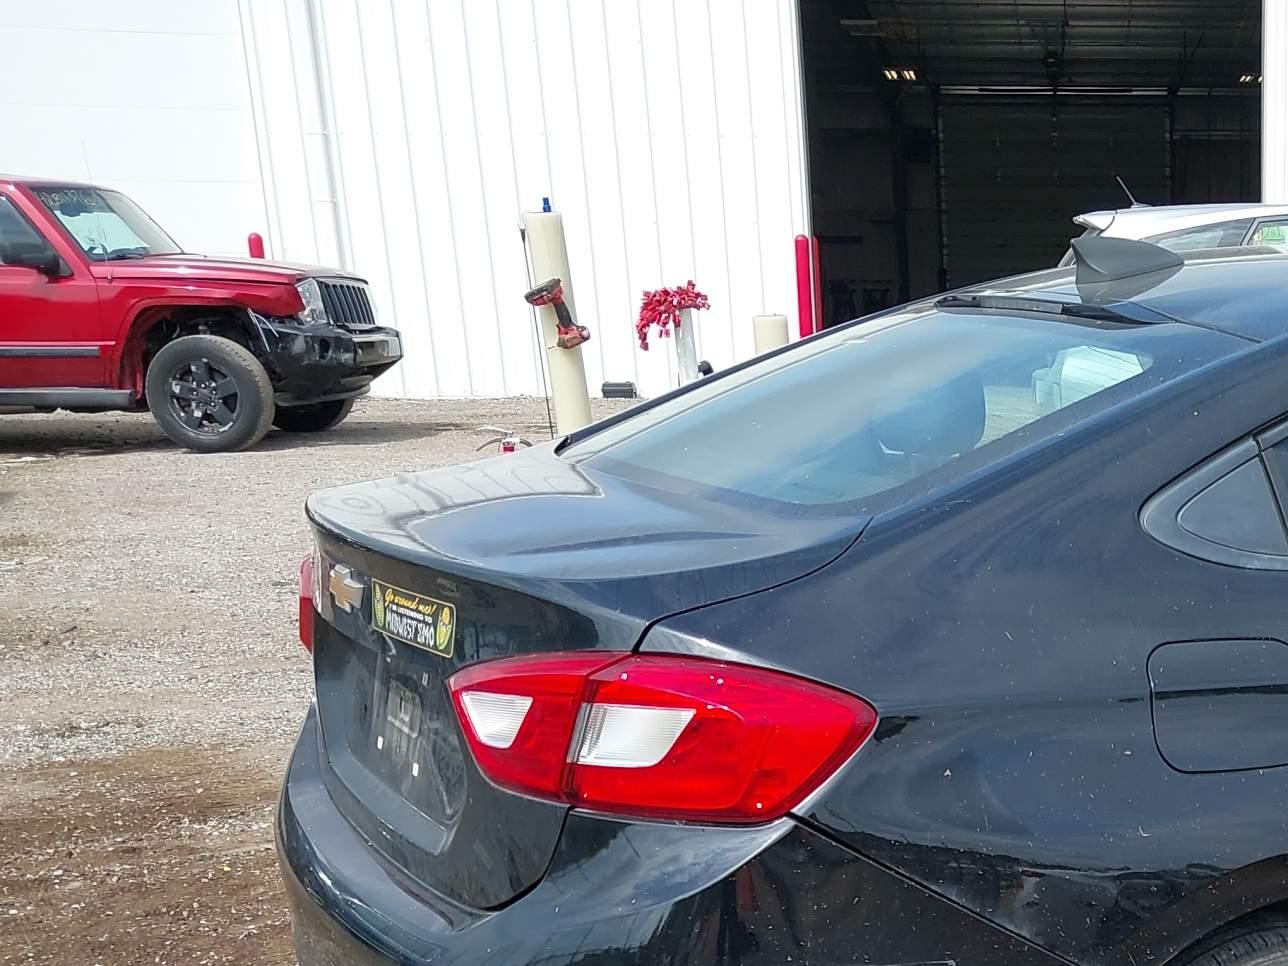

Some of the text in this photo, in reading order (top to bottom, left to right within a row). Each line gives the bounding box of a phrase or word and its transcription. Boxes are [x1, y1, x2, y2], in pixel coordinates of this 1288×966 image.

[385, 606, 435, 648] MIDWEST EMO
[424, 615, 433, 624] TO
